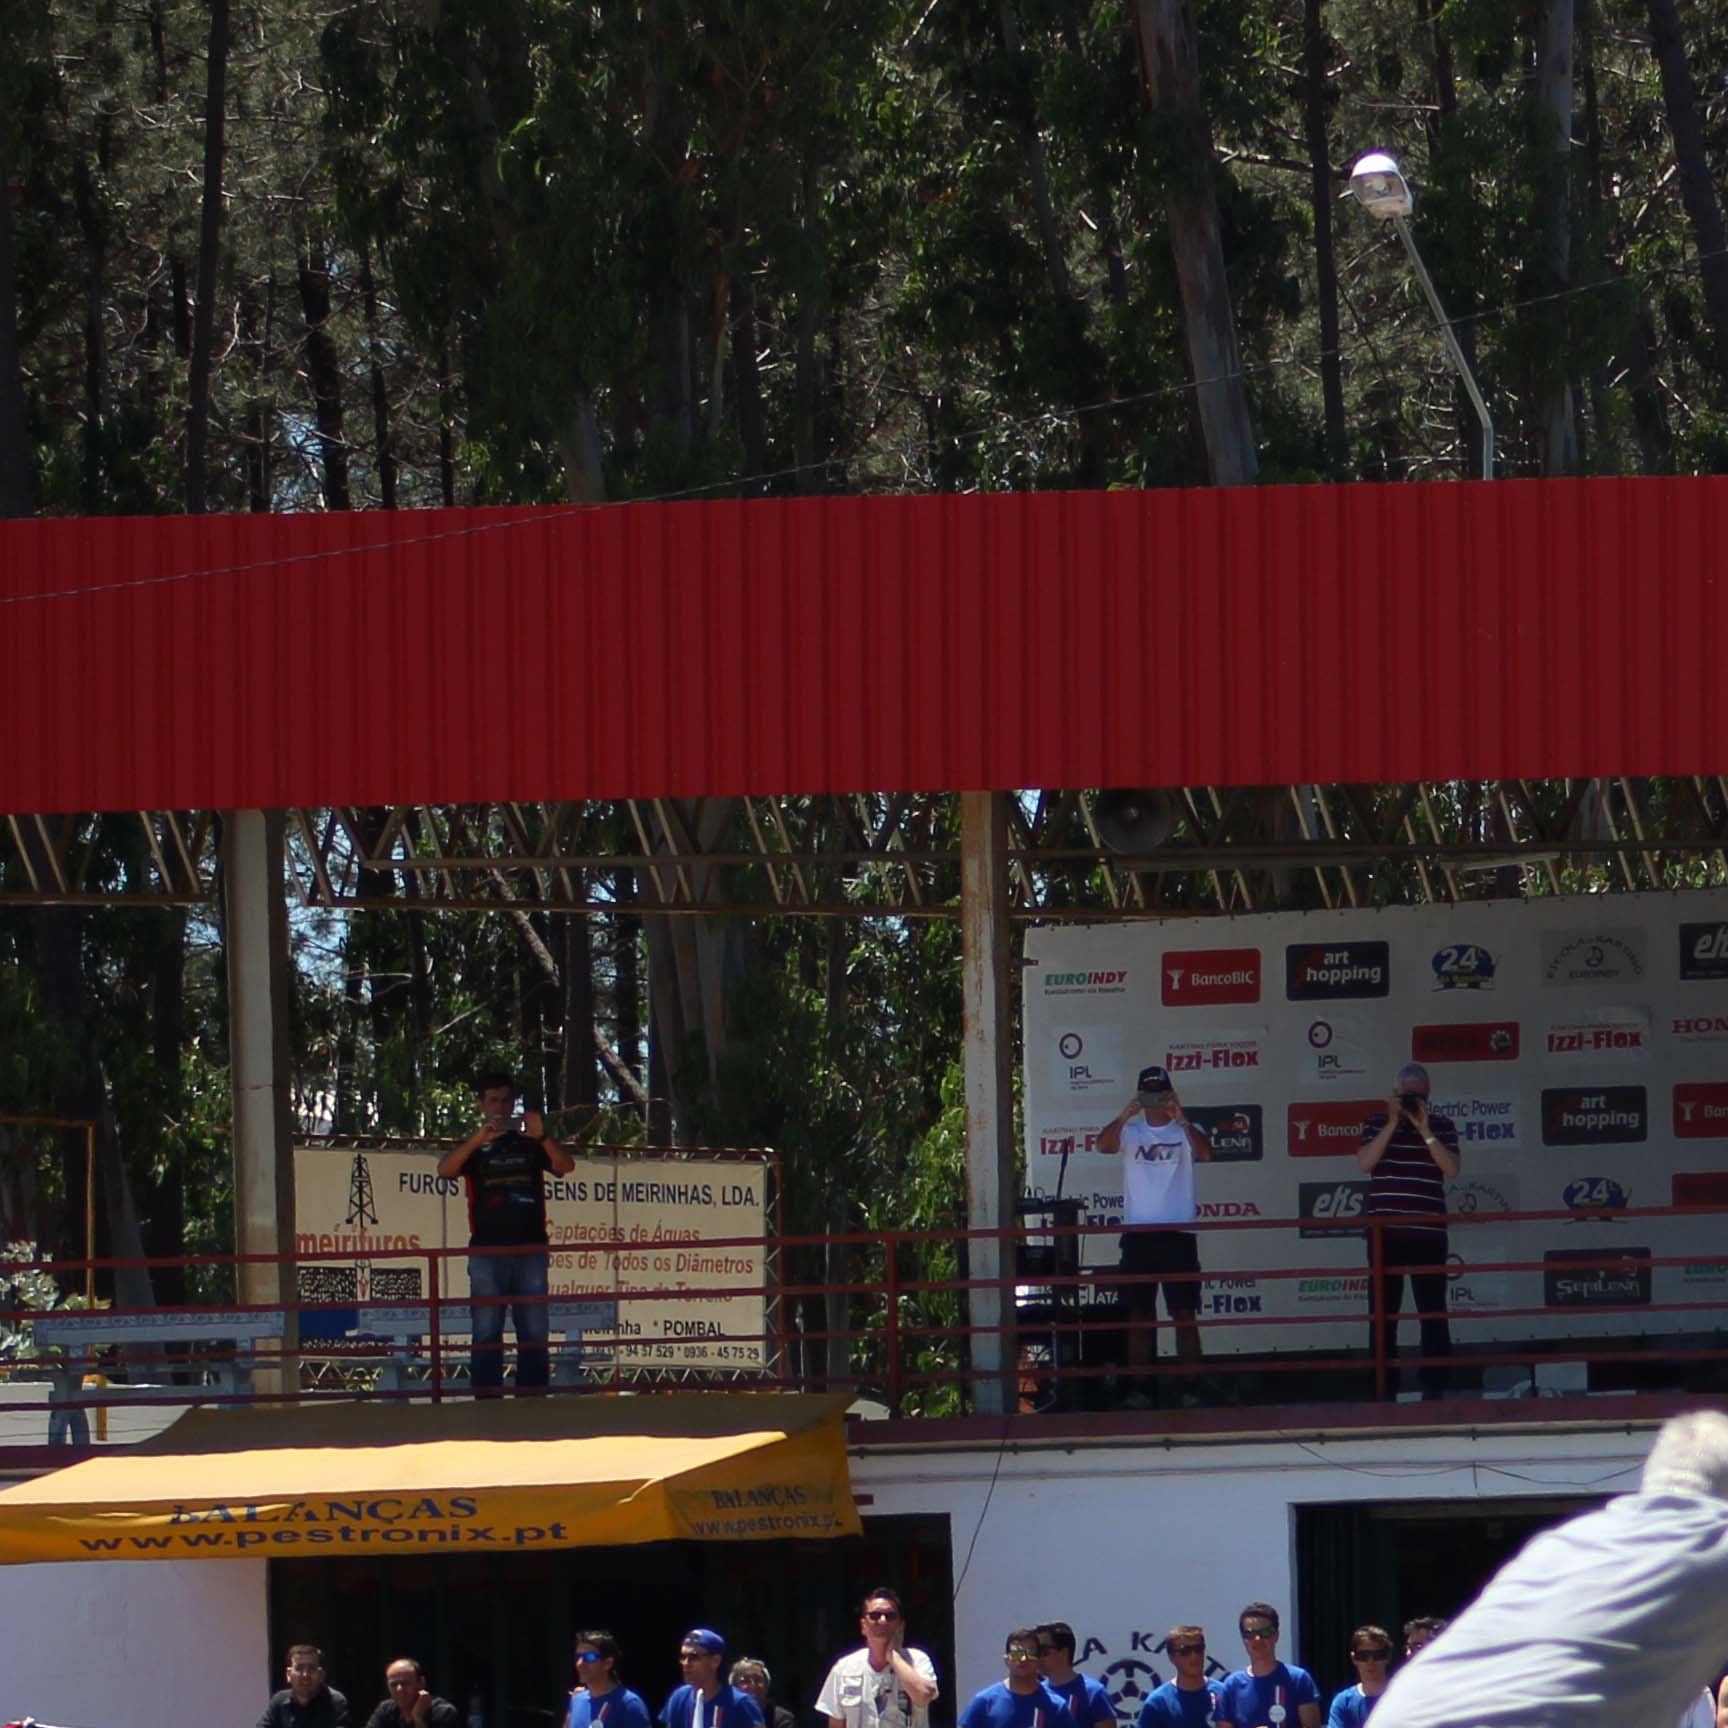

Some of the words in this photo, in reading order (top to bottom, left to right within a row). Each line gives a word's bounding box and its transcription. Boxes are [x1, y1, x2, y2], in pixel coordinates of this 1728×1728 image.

[1323, 951, 1350, 966] art
[1440, 947, 1479, 972] 24
[1044, 971, 1128, 986] EUROINDY
[1191, 970, 1255, 987] BancoBIC
[1306, 965, 1381, 985] hopping
[1548, 1030, 1641, 1052] Izzi-Flex
[1167, 1049, 1258, 1071] Izzi-Flex
[1318, 1055, 1341, 1068] IPL
[1070, 1066, 1092, 1079] IPL
[1472, 1100, 1512, 1115] Power
[1580, 1095, 1606, 1109] art
[1563, 1111, 1639, 1130] hopping
[399, 1172, 460, 1197] FUROS
[594, 1182, 616, 1202] DE
[621, 1183, 717, 1208] MEIRINHAS,
[721, 1185, 760, 1207] LDA.
[654, 1256, 671, 1273] os
[1298, 1279, 1368, 1292] EUROIND
[663, 1320, 726, 1337] POMBAL
[170, 1496, 478, 1525] BALANÇAS
[79, 1521, 567, 1552] www.pestronix.pt
